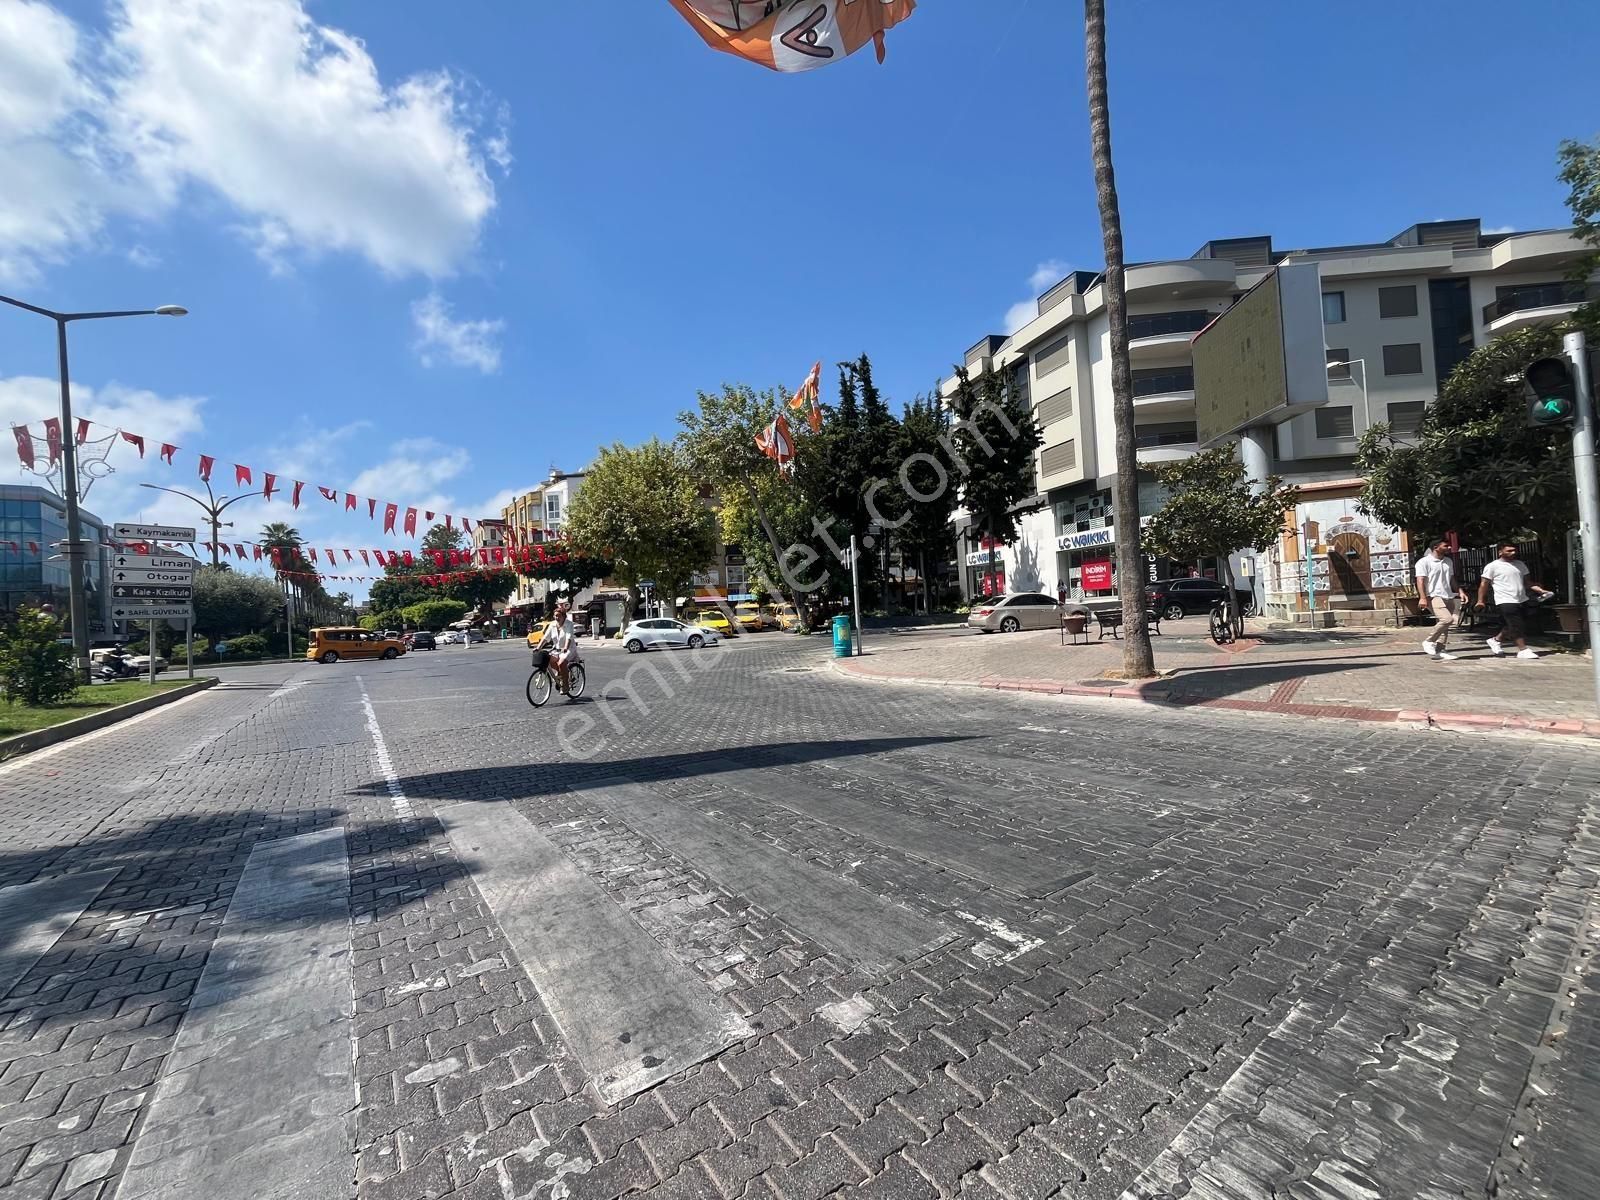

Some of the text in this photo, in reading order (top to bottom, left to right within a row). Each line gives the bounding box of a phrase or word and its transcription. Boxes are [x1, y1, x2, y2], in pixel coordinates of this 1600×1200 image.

[136, 527, 192, 538] Kaymakamlık
[1058, 538, 1071, 550] LC
[151, 558, 191, 568] Liman
[147, 572, 190, 582] Otogar
[128, 608, 189, 616] SAHİL GÜVENLİK
